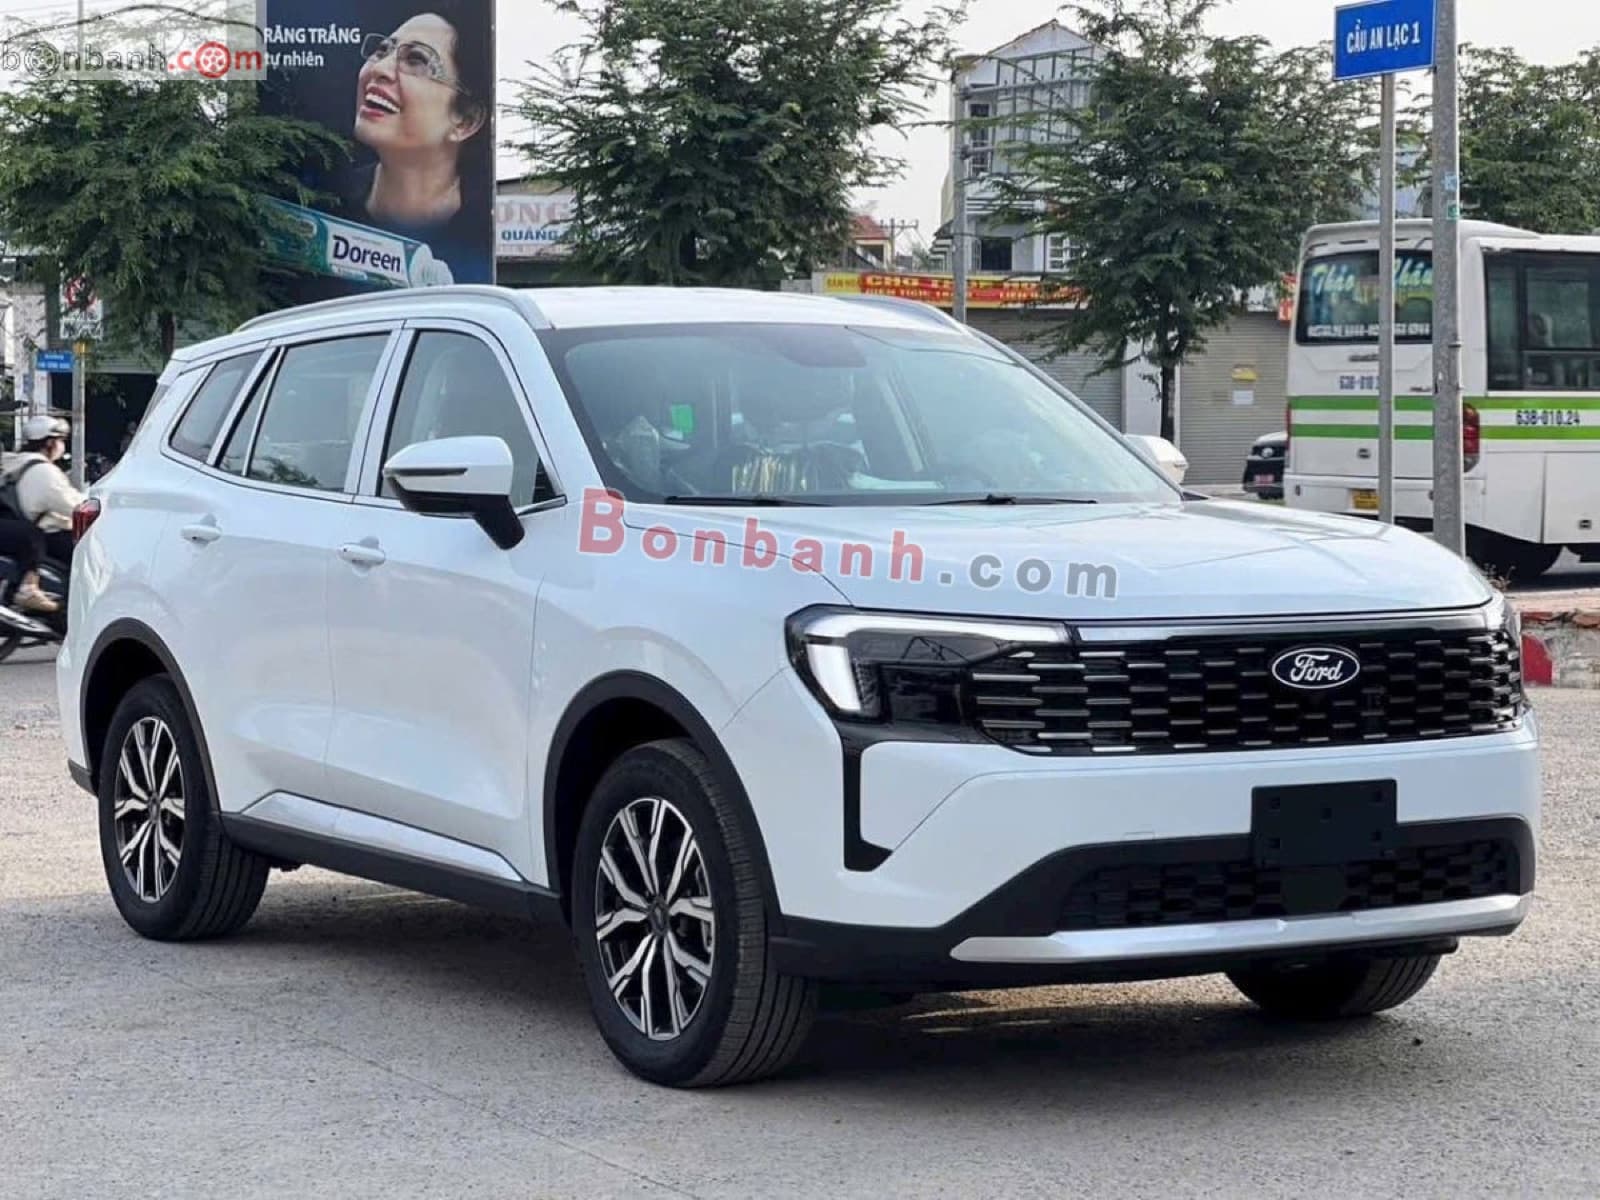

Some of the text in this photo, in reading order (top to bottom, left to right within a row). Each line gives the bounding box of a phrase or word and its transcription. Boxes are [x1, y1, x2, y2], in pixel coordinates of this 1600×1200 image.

[264, 23, 361, 44] RĂNG TRẮNG
[1346, 19, 1421, 54] CẦU AN LẠC 1
[283, 50, 325, 67] nhiên
[332, 234, 401, 273] Doreen
[1290, 653, 1344, 682] Ford
